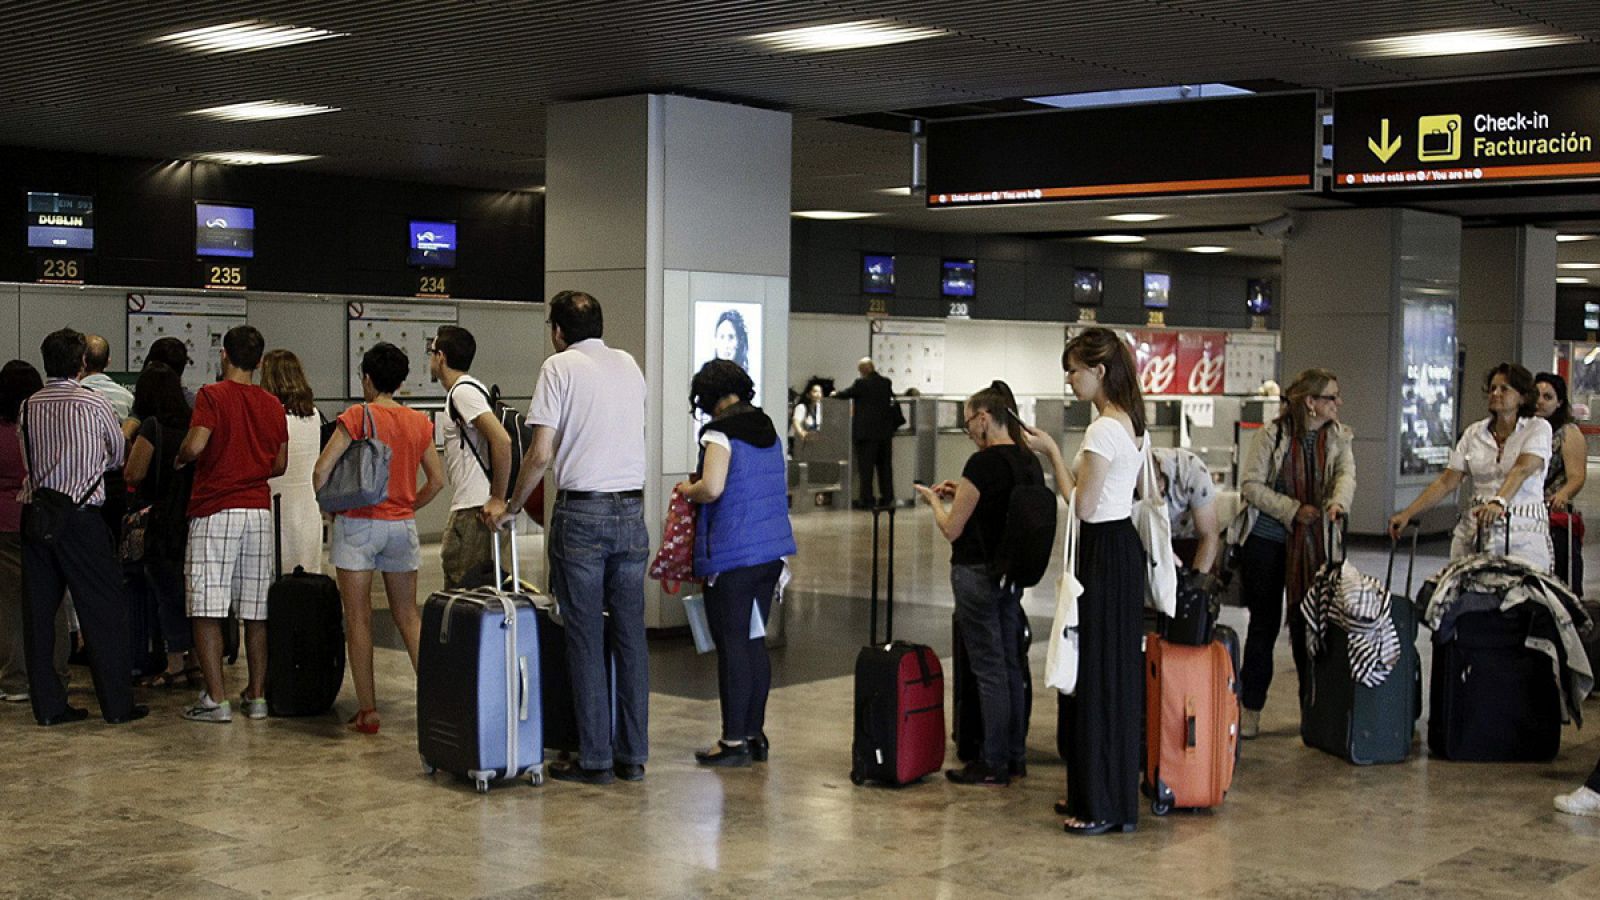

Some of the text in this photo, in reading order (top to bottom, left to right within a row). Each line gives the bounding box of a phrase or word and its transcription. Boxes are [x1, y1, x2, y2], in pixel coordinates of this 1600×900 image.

[1474, 111, 1549, 133] Check-in
[1473, 131, 1592, 157] Facturación
[1363, 173, 1385, 183] Usted
[1432, 170, 1447, 180] You
[1448, 171, 1463, 179] are
[38, 214, 83, 226] DUBLIN
[43, 259, 78, 277] 236
[211, 266, 241, 285] 235
[419, 276, 445, 293] 234
[949, 302, 968, 315] 230
